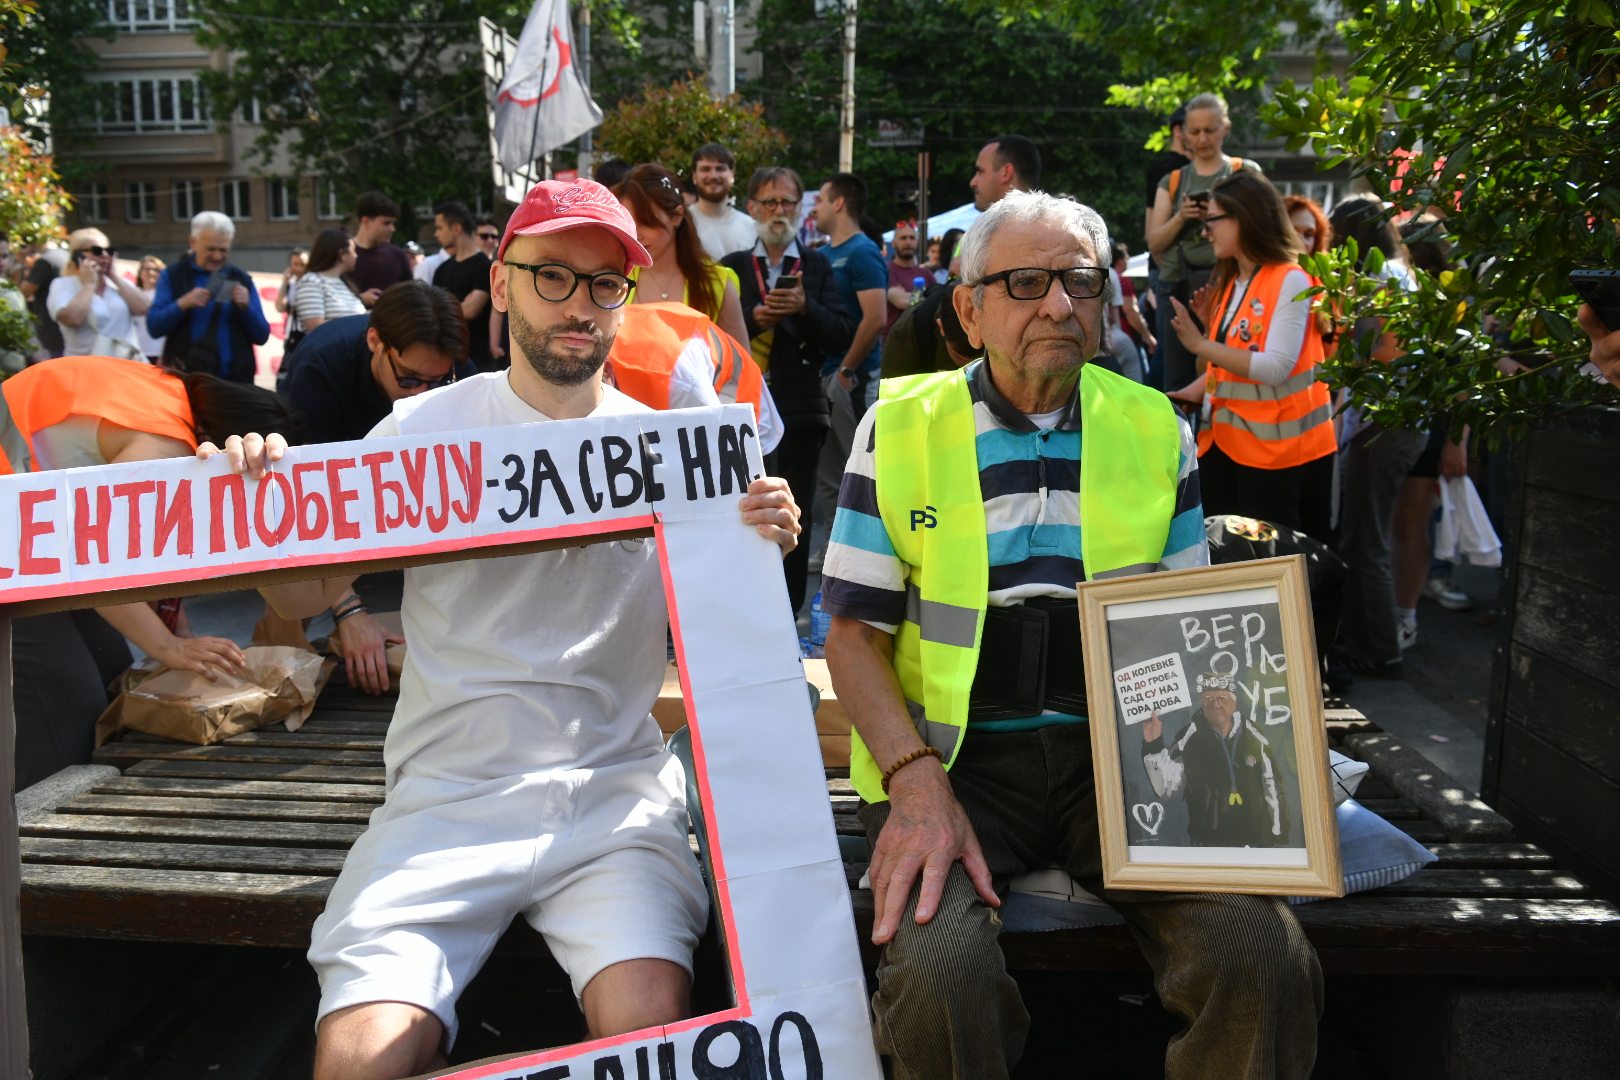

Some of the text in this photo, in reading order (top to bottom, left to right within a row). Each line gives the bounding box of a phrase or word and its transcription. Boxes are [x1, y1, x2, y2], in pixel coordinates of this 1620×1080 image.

[0, 478, 195, 579] ЕНТИ
[578, 430, 666, 514] СВЕ
[676, 423, 760, 501] НАС
[1117, 658, 1176, 682] ОД КОЛЕВКЕ
[1120, 670, 1178, 694] ПА ДО ГРОБА
[1123, 682, 1180, 705] САД СУ НАЈ
[1126, 695, 1182, 717] ГОРА ДОБА
